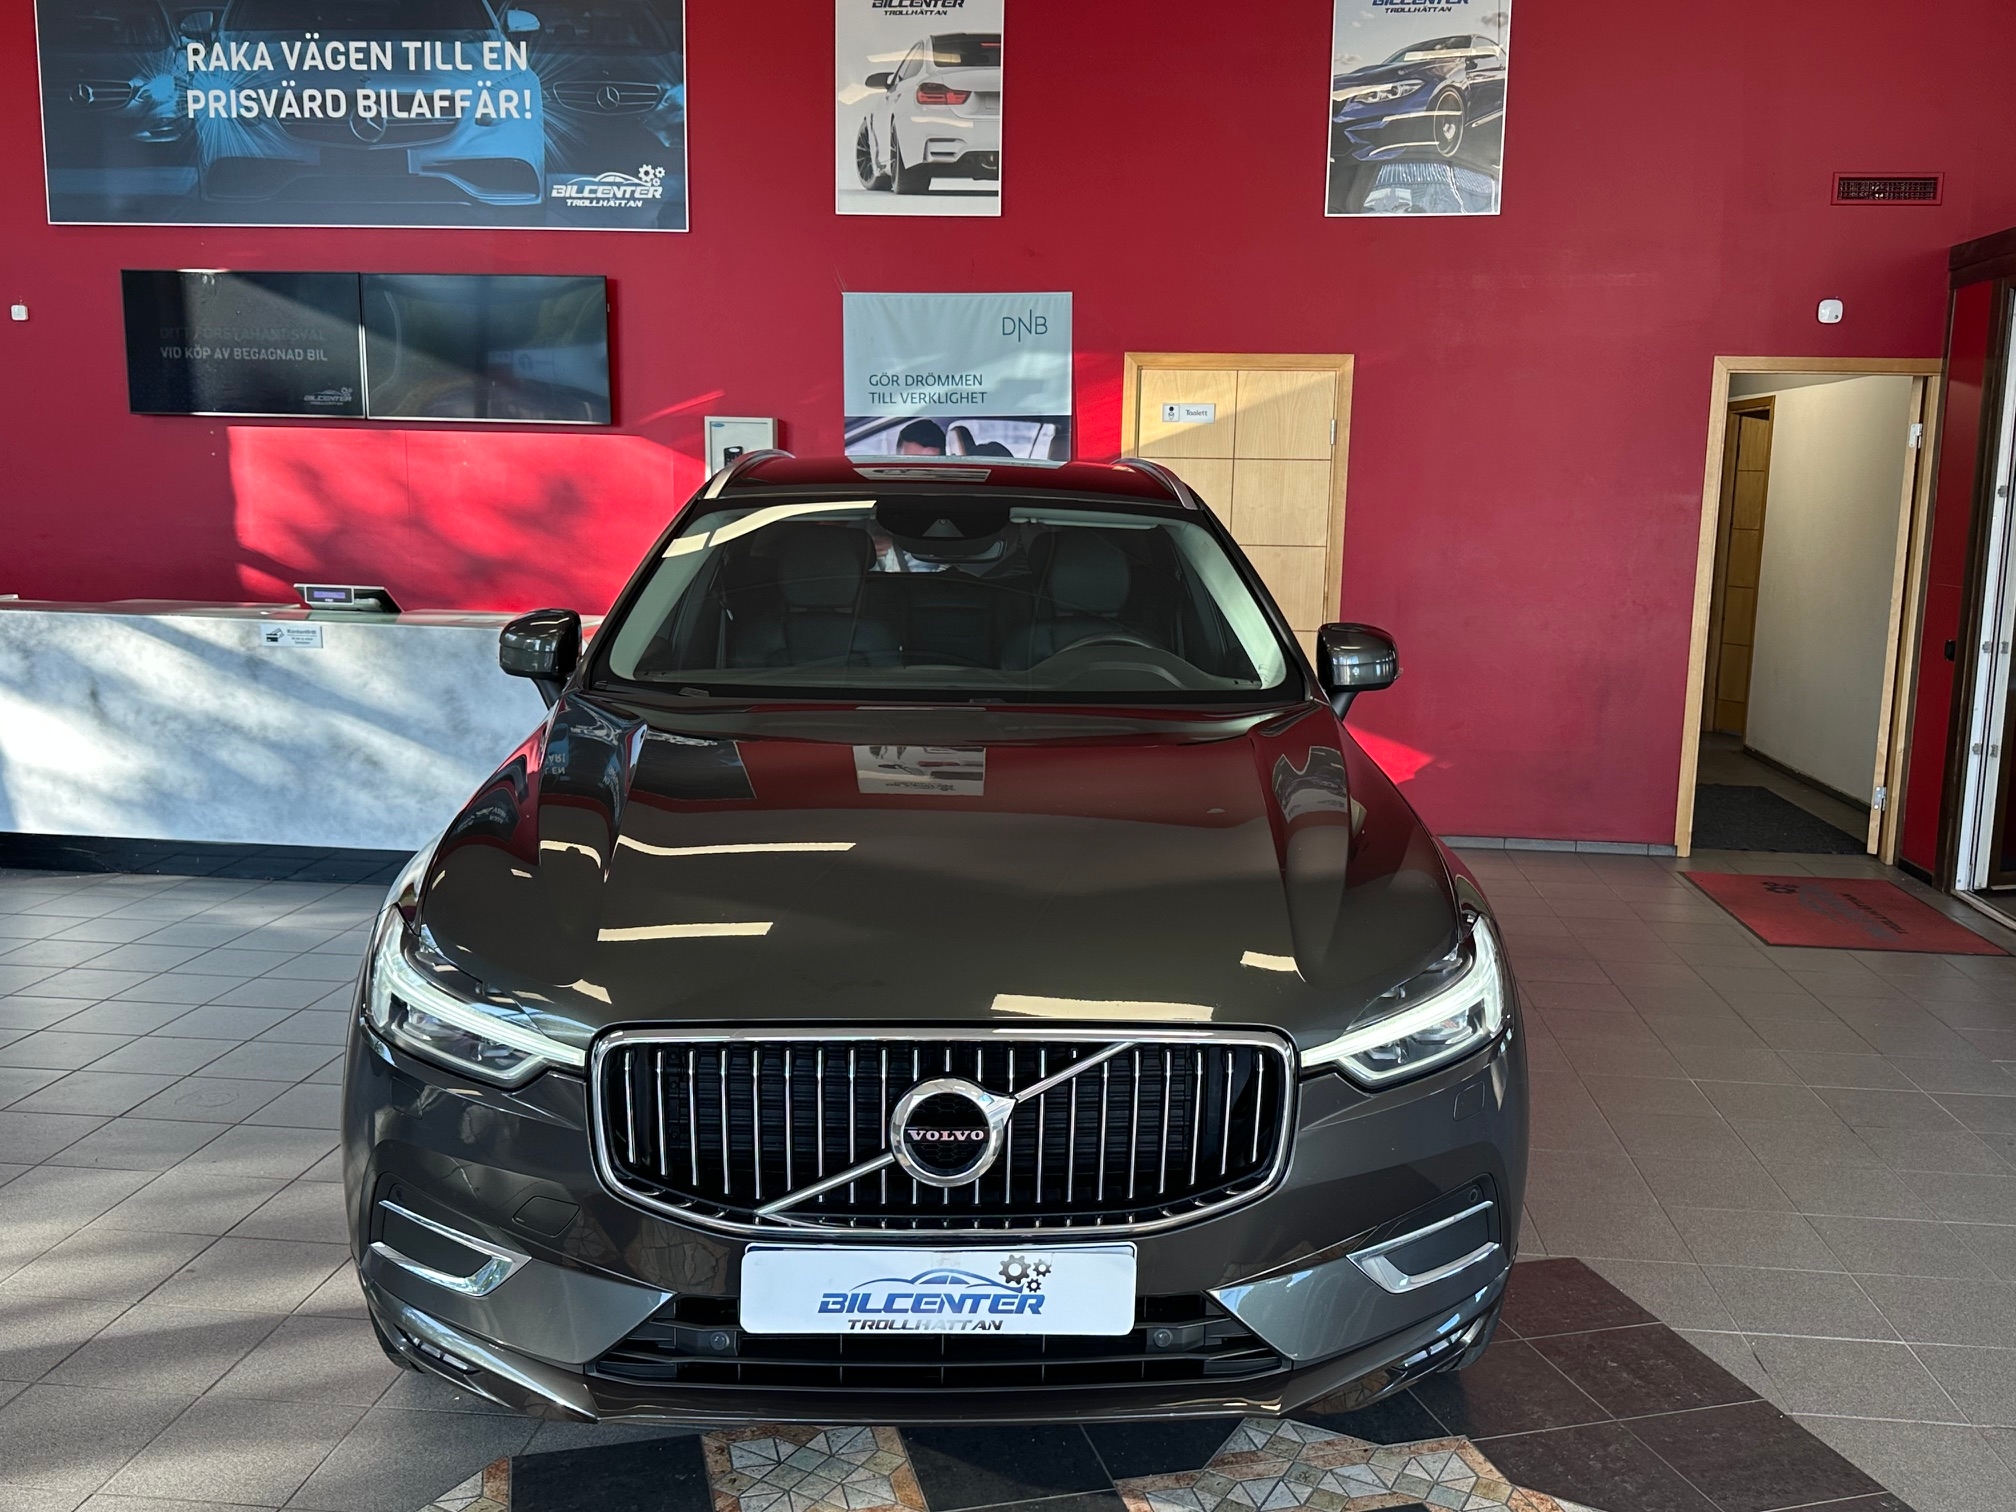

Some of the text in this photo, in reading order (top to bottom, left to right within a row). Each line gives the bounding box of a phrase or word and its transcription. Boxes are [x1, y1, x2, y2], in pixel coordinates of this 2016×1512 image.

[1385, 6, 1453, 14] TROLLHÄTTAN
[186, 32, 527, 72] RAKA VÄGEN TILL EN
[186, 79, 533, 120] PRISVÄRD BILAFFÄR!
[551, 184, 663, 199] BILCENTER
[566, 198, 643, 208] TROLLHÄTTAN
[1002, 309, 1048, 343] DNB
[160, 341, 328, 361] VID KÖP AV BEGAGNAD BIL
[869, 372, 983, 387] GÖR DRÖMMEN
[869, 391, 988, 404] TILL VERKLIGHET
[907, 1130, 984, 1141] VOLVO
[818, 1293, 1046, 1315] BILCENTER
